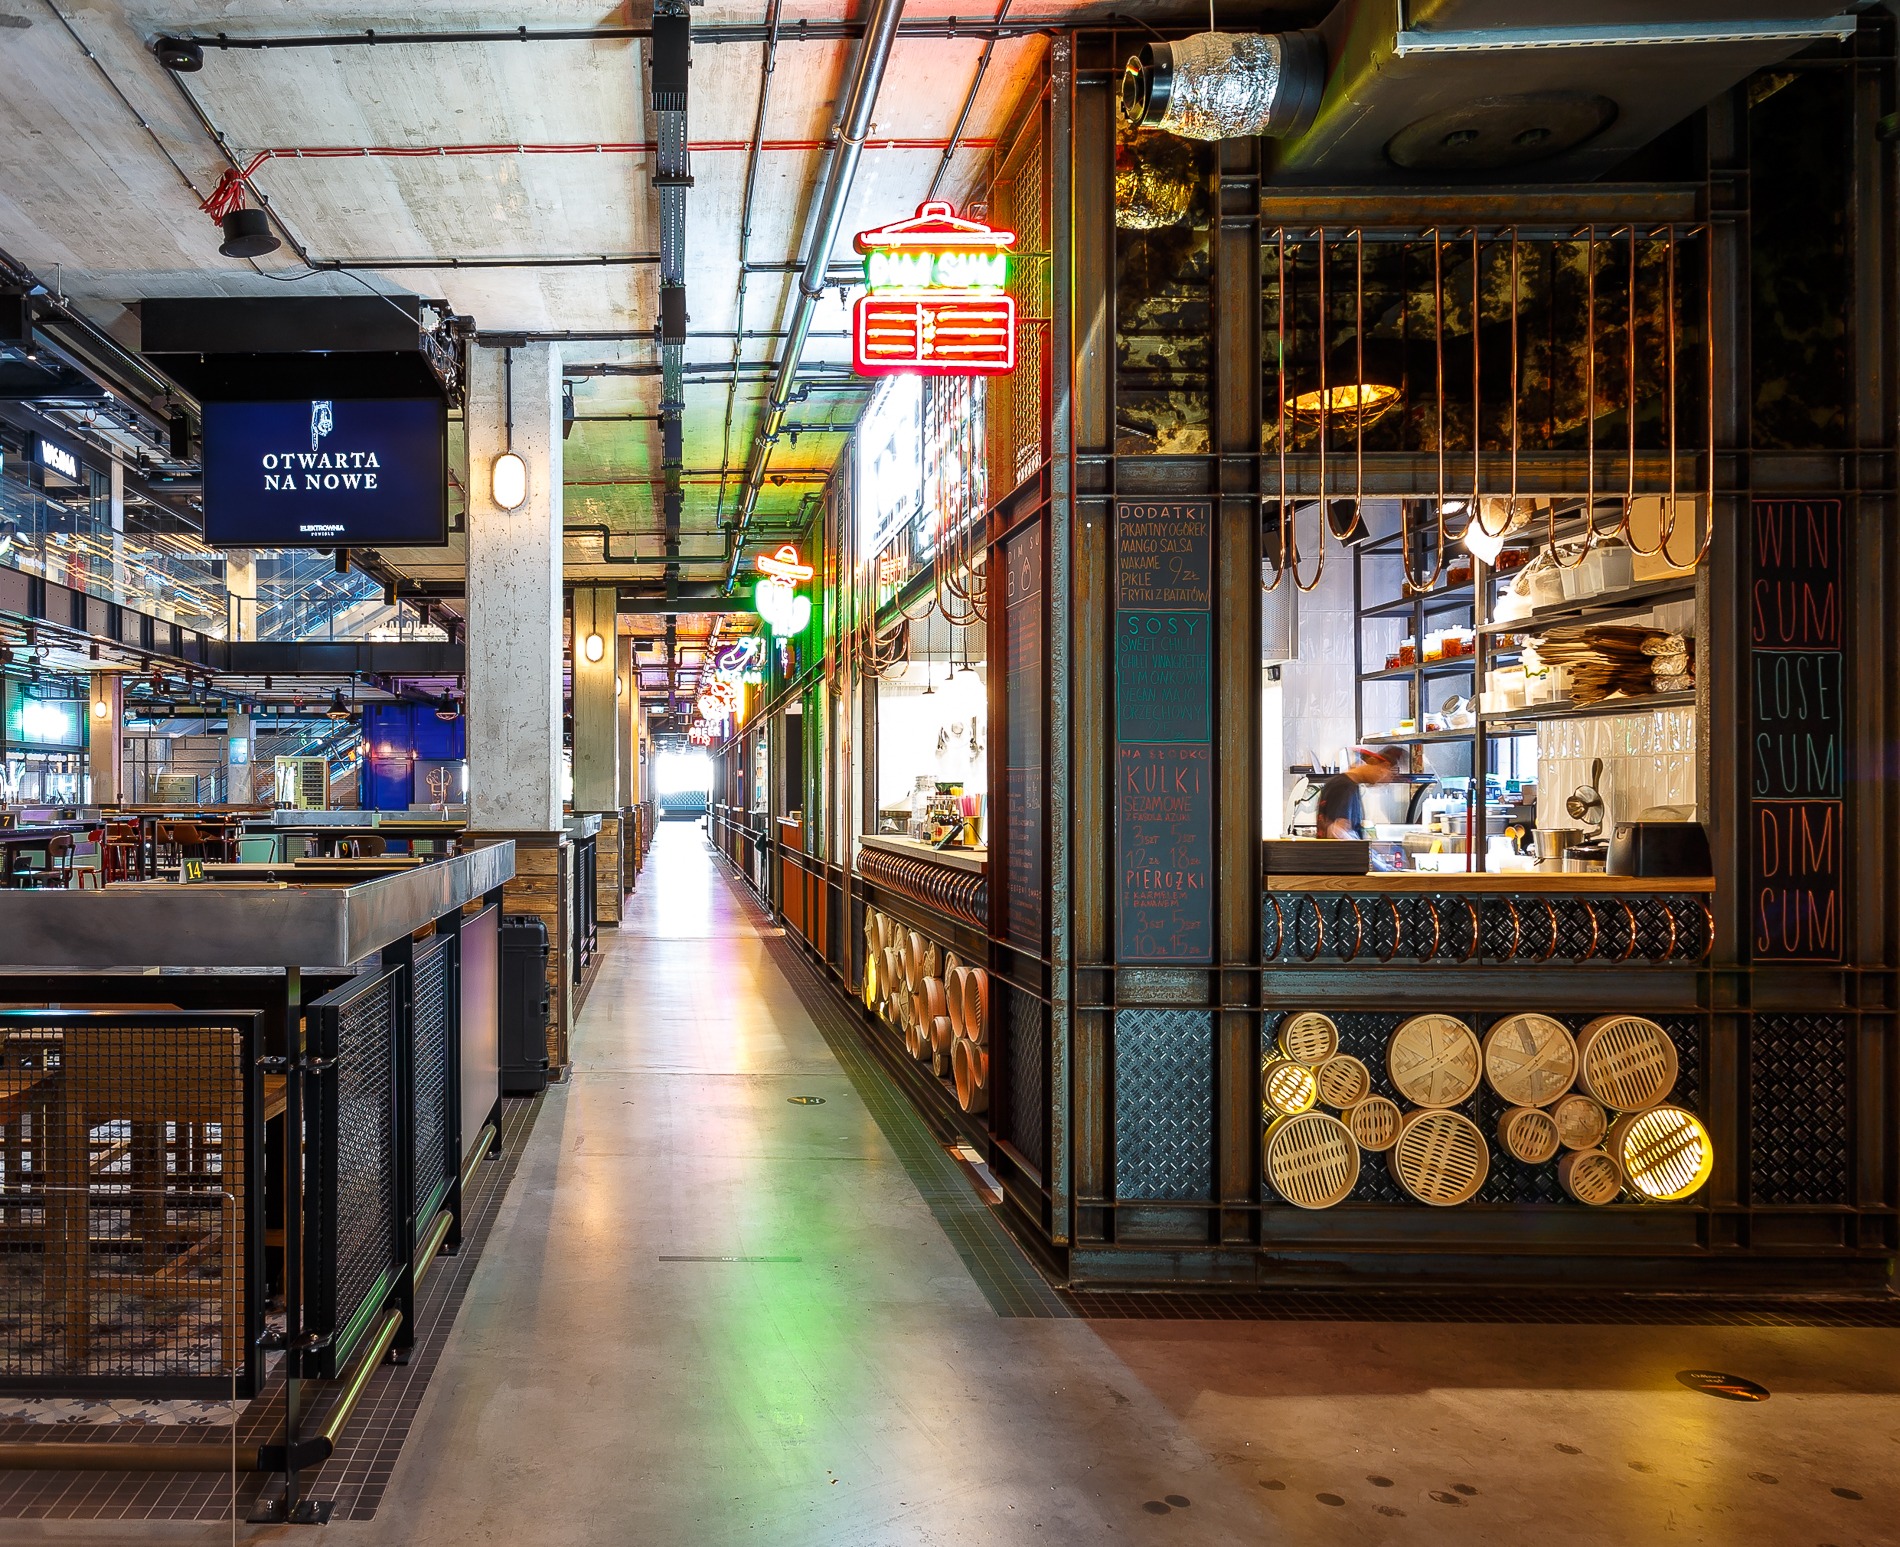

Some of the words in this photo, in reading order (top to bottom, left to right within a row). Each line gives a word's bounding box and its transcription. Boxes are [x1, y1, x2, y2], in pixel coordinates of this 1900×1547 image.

[262, 452, 380, 469] OTWARTA
[264, 474, 297, 490] NA
[305, 474, 378, 490] NOWE
[1120, 506, 1204, 520] DODATKI
[1120, 522, 1168, 537] PIKANTNY
[1168, 522, 1208, 537] OGÓREK
[1757, 504, 1827, 568] WIN
[1120, 539, 1158, 553] MANGO
[1160, 538, 1193, 552] SALSA
[1120, 555, 1160, 570] WAKAME
[1168, 556, 1182, 584] 9
[1121, 572, 1152, 586] PIKLE
[1121, 588, 1154, 602] FRYTKI
[1156, 589, 1162, 600] Z
[1164, 586, 1208, 602] BATATÓW
[1754, 579, 1833, 642] SUM
[1128, 616, 1198, 635] SOSY
[1120, 634, 1156, 652] SWEET
[716, 669, 762, 684] VEGAN
[1121, 670, 1206, 685] LIMONKOWY
[1121, 688, 1156, 701] VEGAN
[1758, 656, 1830, 720] LOSE
[1122, 704, 1202, 720] ORZECHOWY
[1121, 750, 1140, 758] NA
[1757, 732, 1834, 794] SUM
[1128, 764, 1199, 794] KULKI
[1124, 795, 1192, 812] SEZAMOWE
[342, 842, 348, 856] 9
[1761, 806, 1831, 877] DIM
[186, 861, 202, 880] 14
[1758, 887, 1834, 952] SUM
